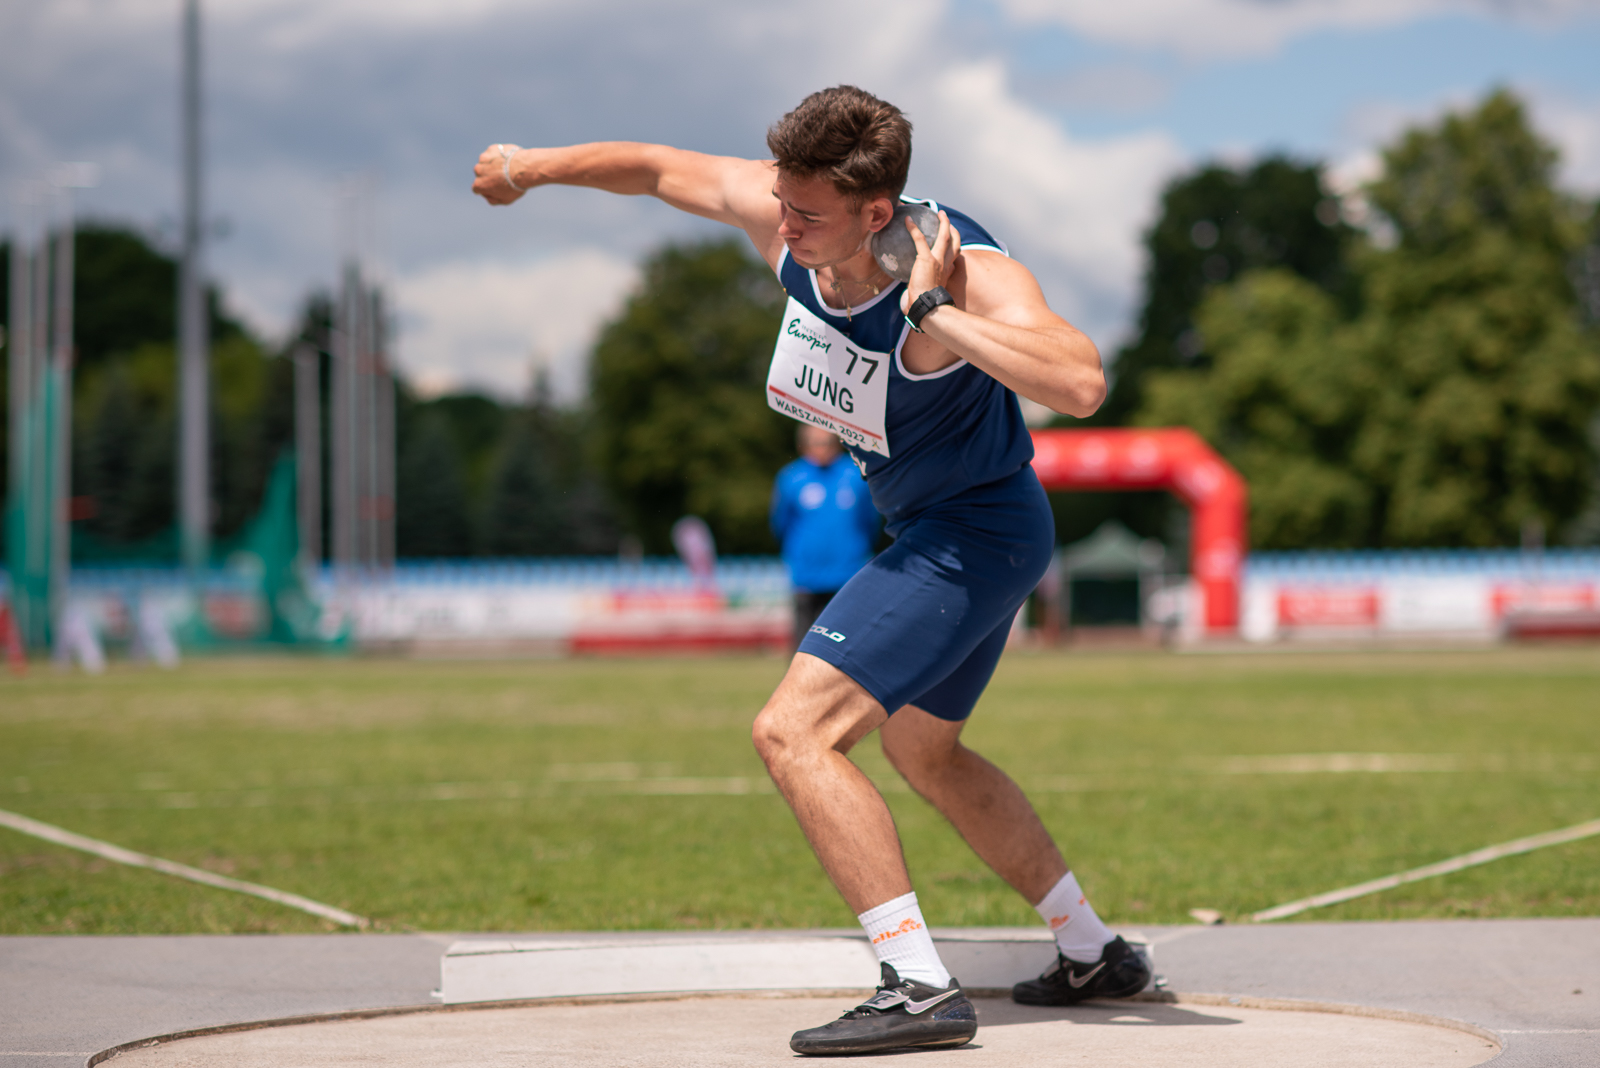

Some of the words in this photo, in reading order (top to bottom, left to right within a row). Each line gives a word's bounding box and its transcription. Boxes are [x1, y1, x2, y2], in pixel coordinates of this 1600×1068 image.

[787, 318, 832, 354] Europol
[845, 346, 879, 385] 77
[794, 364, 854, 413] JUNG
[775, 397, 837, 430] WARSZAWA
[839, 425, 866, 444] 2022
